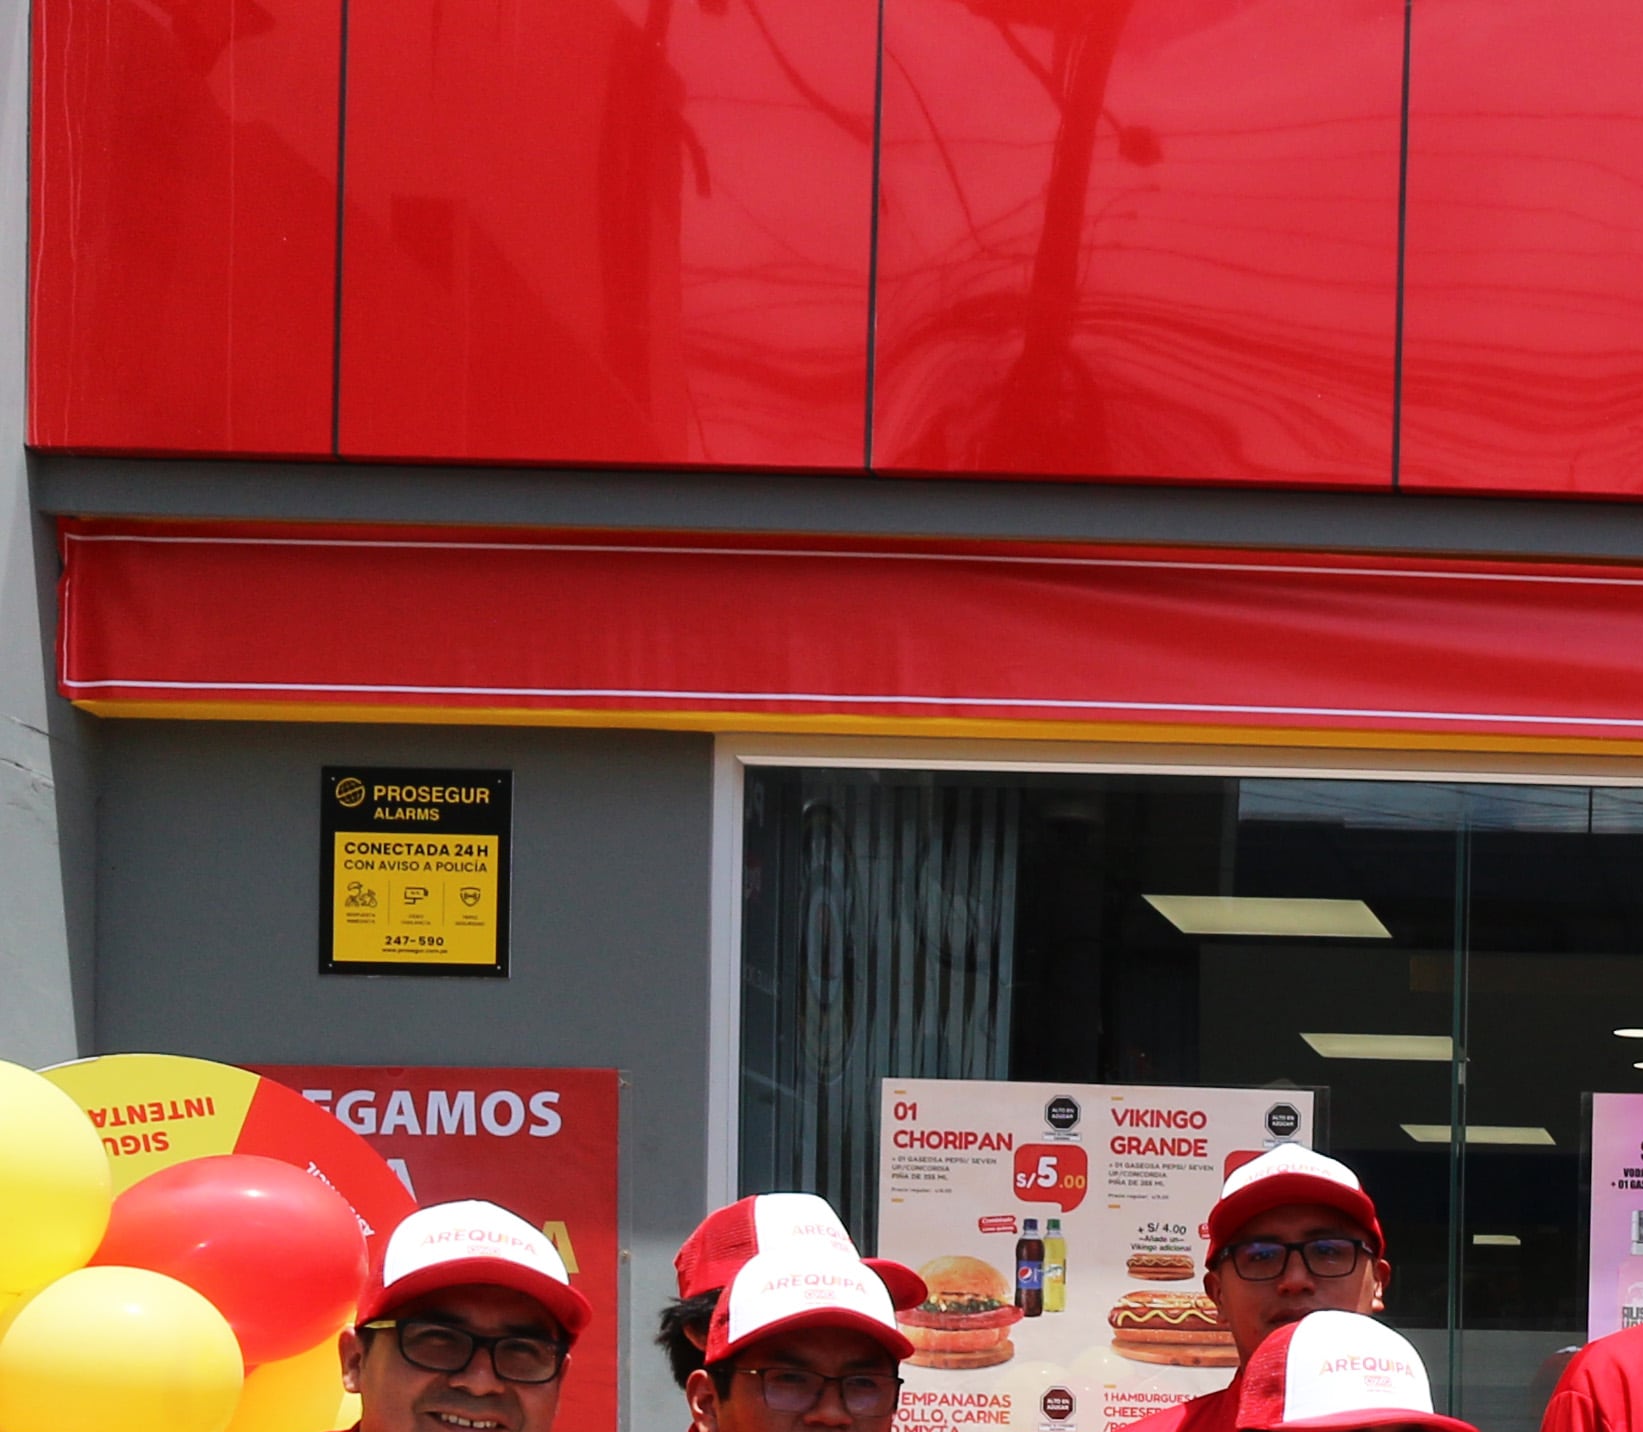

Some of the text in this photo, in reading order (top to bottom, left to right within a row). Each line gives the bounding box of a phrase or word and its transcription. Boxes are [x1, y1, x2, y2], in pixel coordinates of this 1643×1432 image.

[373, 785, 490, 804] PROSEGUR
[373, 808, 440, 821] ALARMS
[344, 842, 450, 857] CONECTADA
[454, 844, 474, 857] 24
[344, 858, 488, 873] CON AVISO A POLICÍA
[385, 936, 445, 946] 247-590
[893, 1102, 917, 1121] 01
[1111, 1107, 1207, 1130] VIKINGO
[893, 1130, 1013, 1151] CHORIPAN
[1110, 1136, 1208, 1158] GRANDE
[421, 1228, 538, 1256] AREQUIPA
[760, 1273, 867, 1297] AREQUIPA
[1318, 1354, 1417, 1380] AREQUIPA
[901, 1392, 1012, 1408] EMPANADAS
[1111, 1392, 1198, 1403] HAMBURGUES
[893, 1408, 1011, 1425] OLLO, CARNE
